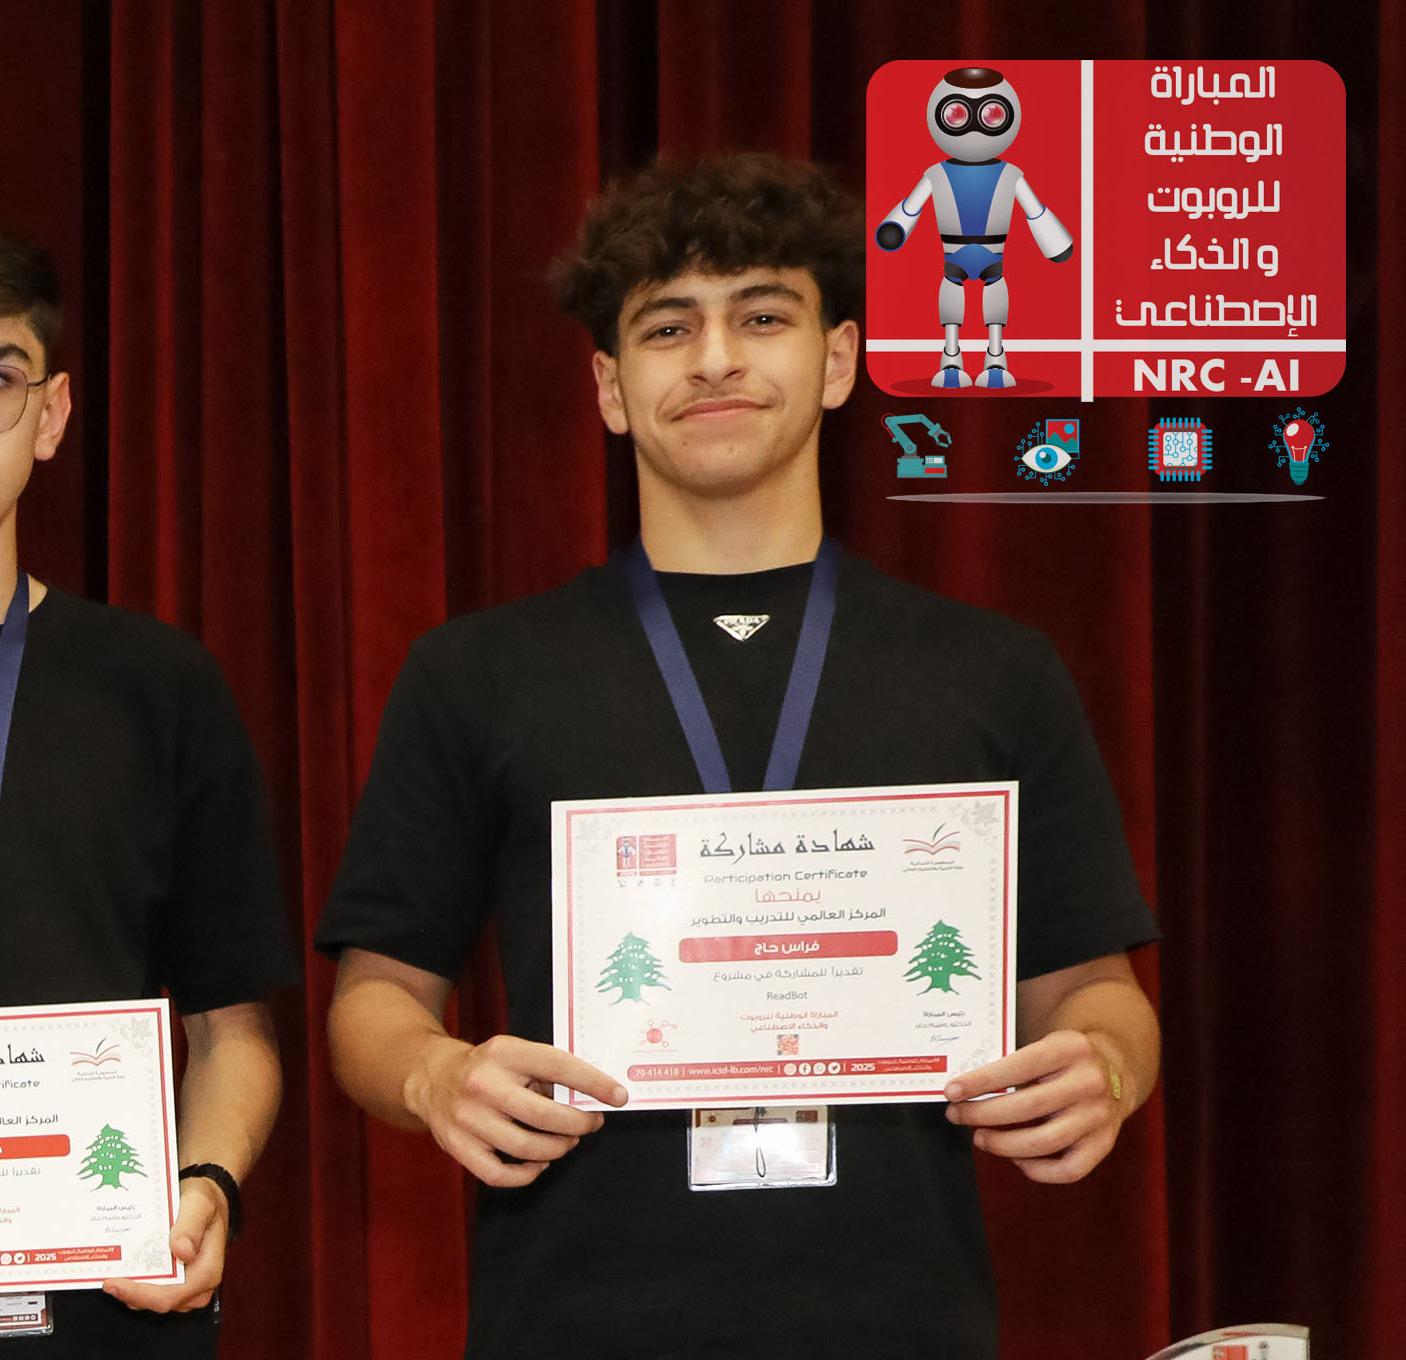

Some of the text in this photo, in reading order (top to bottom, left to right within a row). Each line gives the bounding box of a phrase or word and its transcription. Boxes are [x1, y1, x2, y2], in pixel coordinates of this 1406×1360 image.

[704, 869, 868, 884] Participation Certificate
[766, 991, 808, 1001] ReadBot
[851, 1063, 876, 1071] 2025
[35, 1253, 57, 1261] 2025
